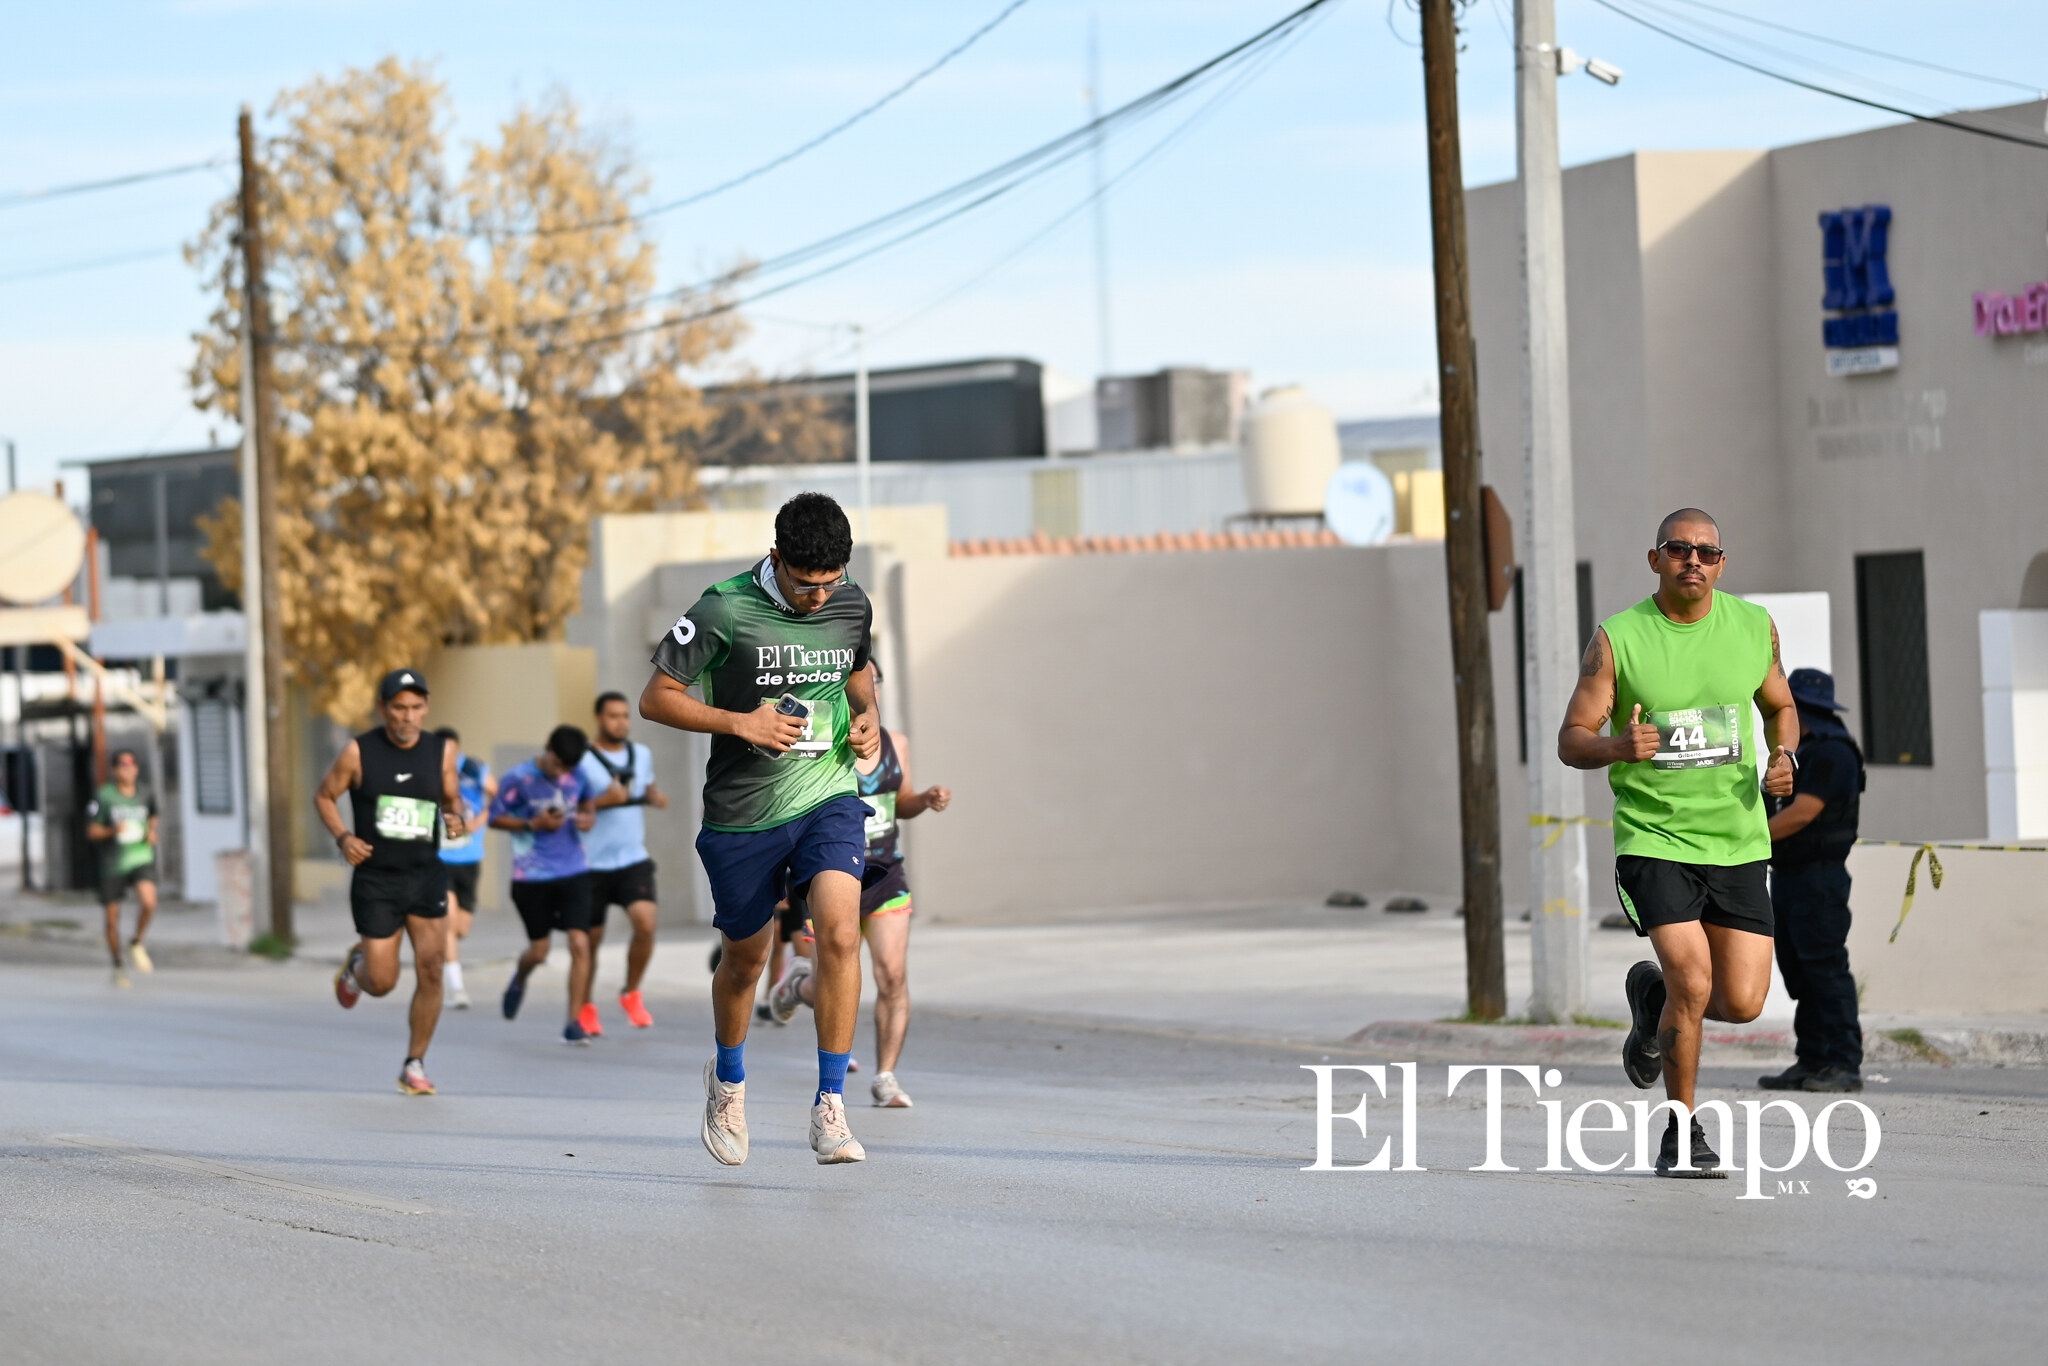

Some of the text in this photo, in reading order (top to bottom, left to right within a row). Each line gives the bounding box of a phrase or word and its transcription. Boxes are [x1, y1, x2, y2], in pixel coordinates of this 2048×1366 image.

[756, 644, 855, 670] El Tiempo
[755, 670, 842, 686] de todos
[1669, 725, 1707, 751] 44
[1730, 717, 1739, 757] MEDALLA
[383, 807, 419, 828] 501
